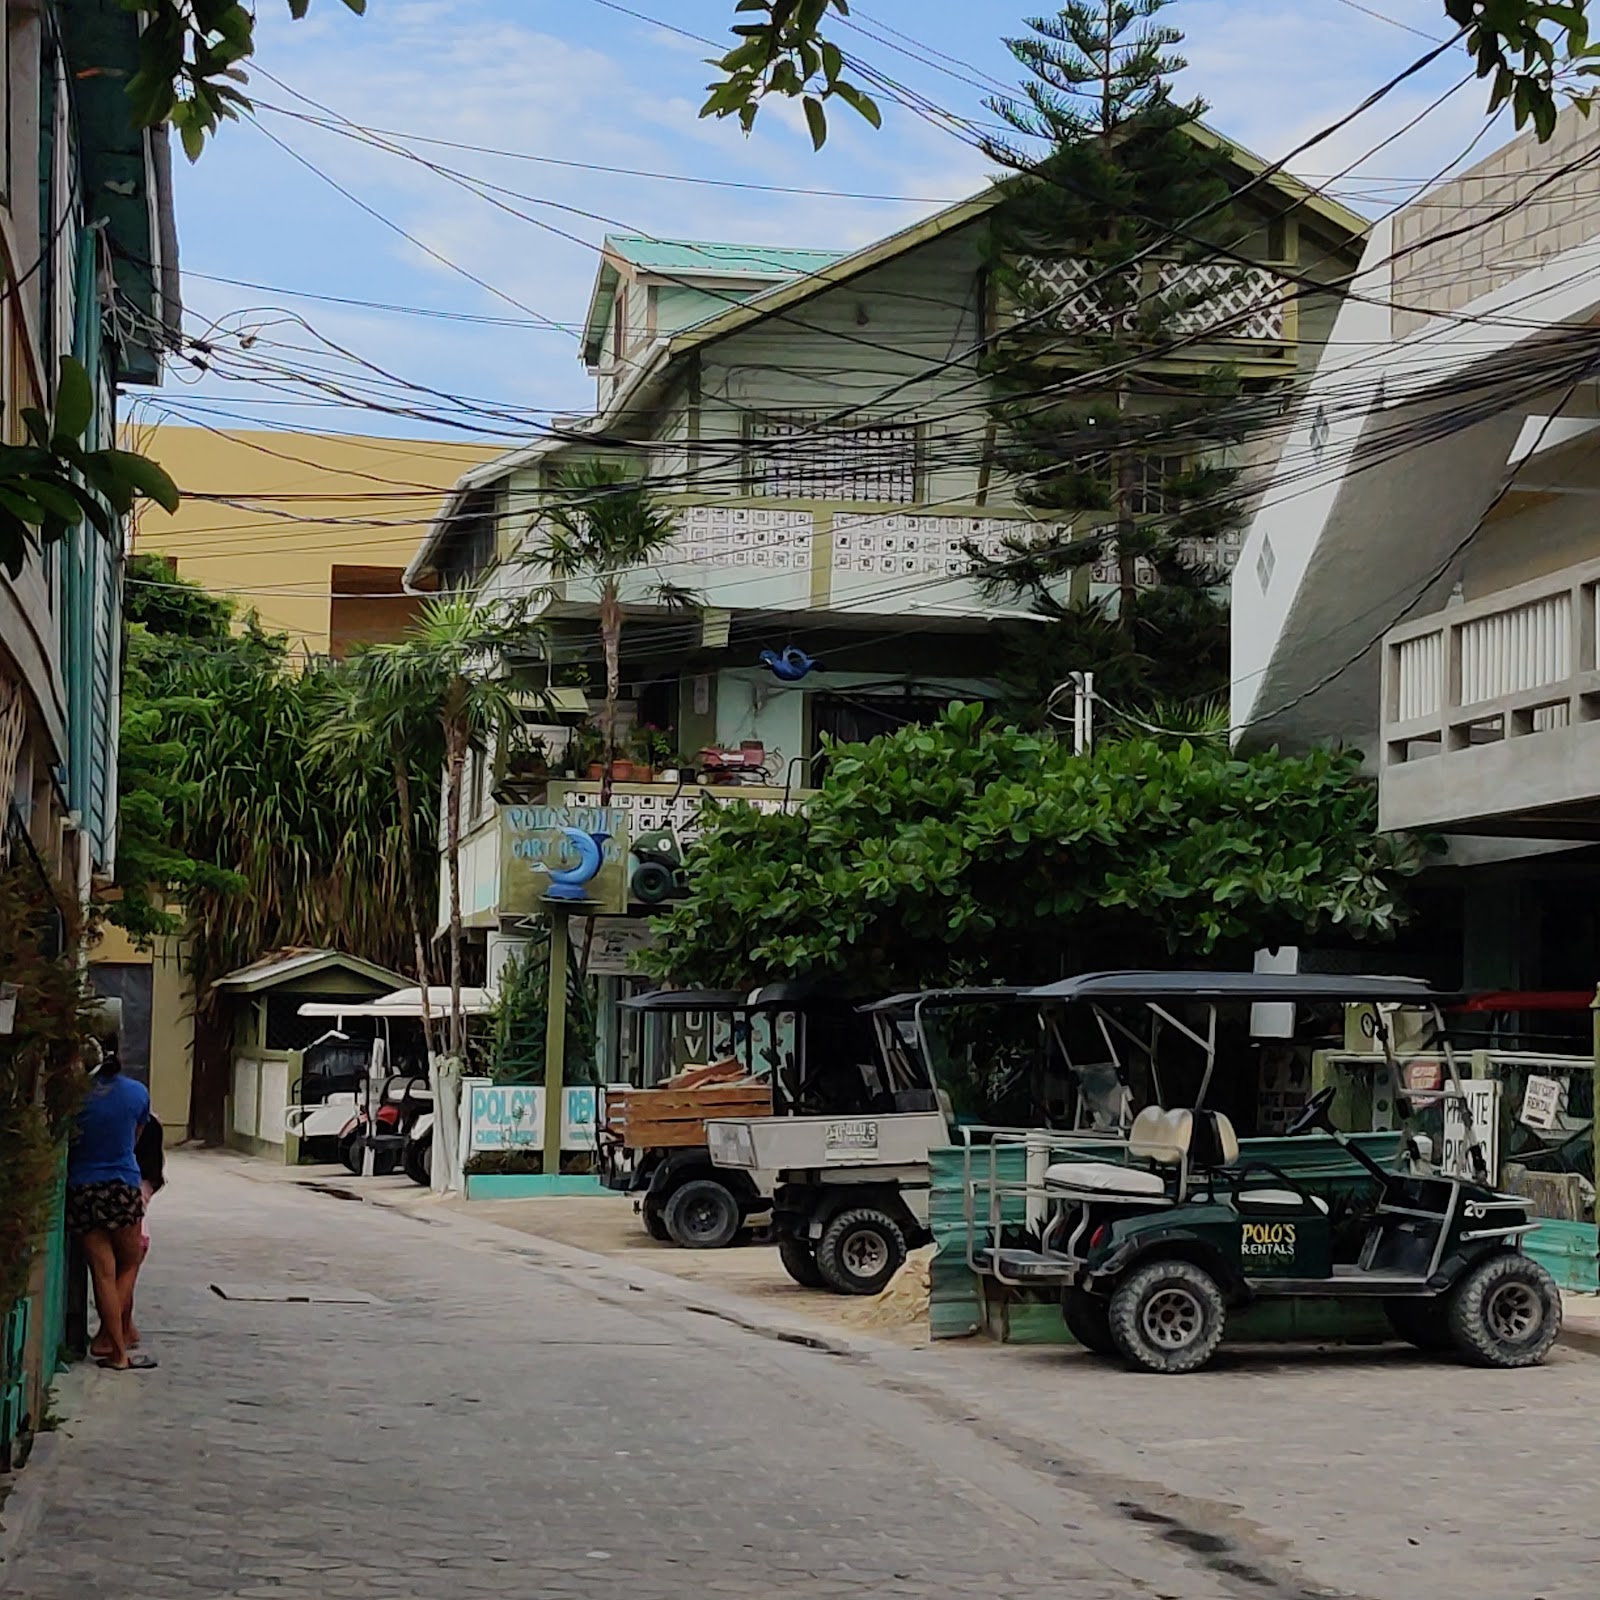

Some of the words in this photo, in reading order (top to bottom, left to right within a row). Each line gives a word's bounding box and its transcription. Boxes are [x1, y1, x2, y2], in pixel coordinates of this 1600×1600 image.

[512, 838, 554, 858] CART
[1242, 1223, 1296, 1244] POLO'S
[1241, 1243, 1295, 1255] RENTALS
